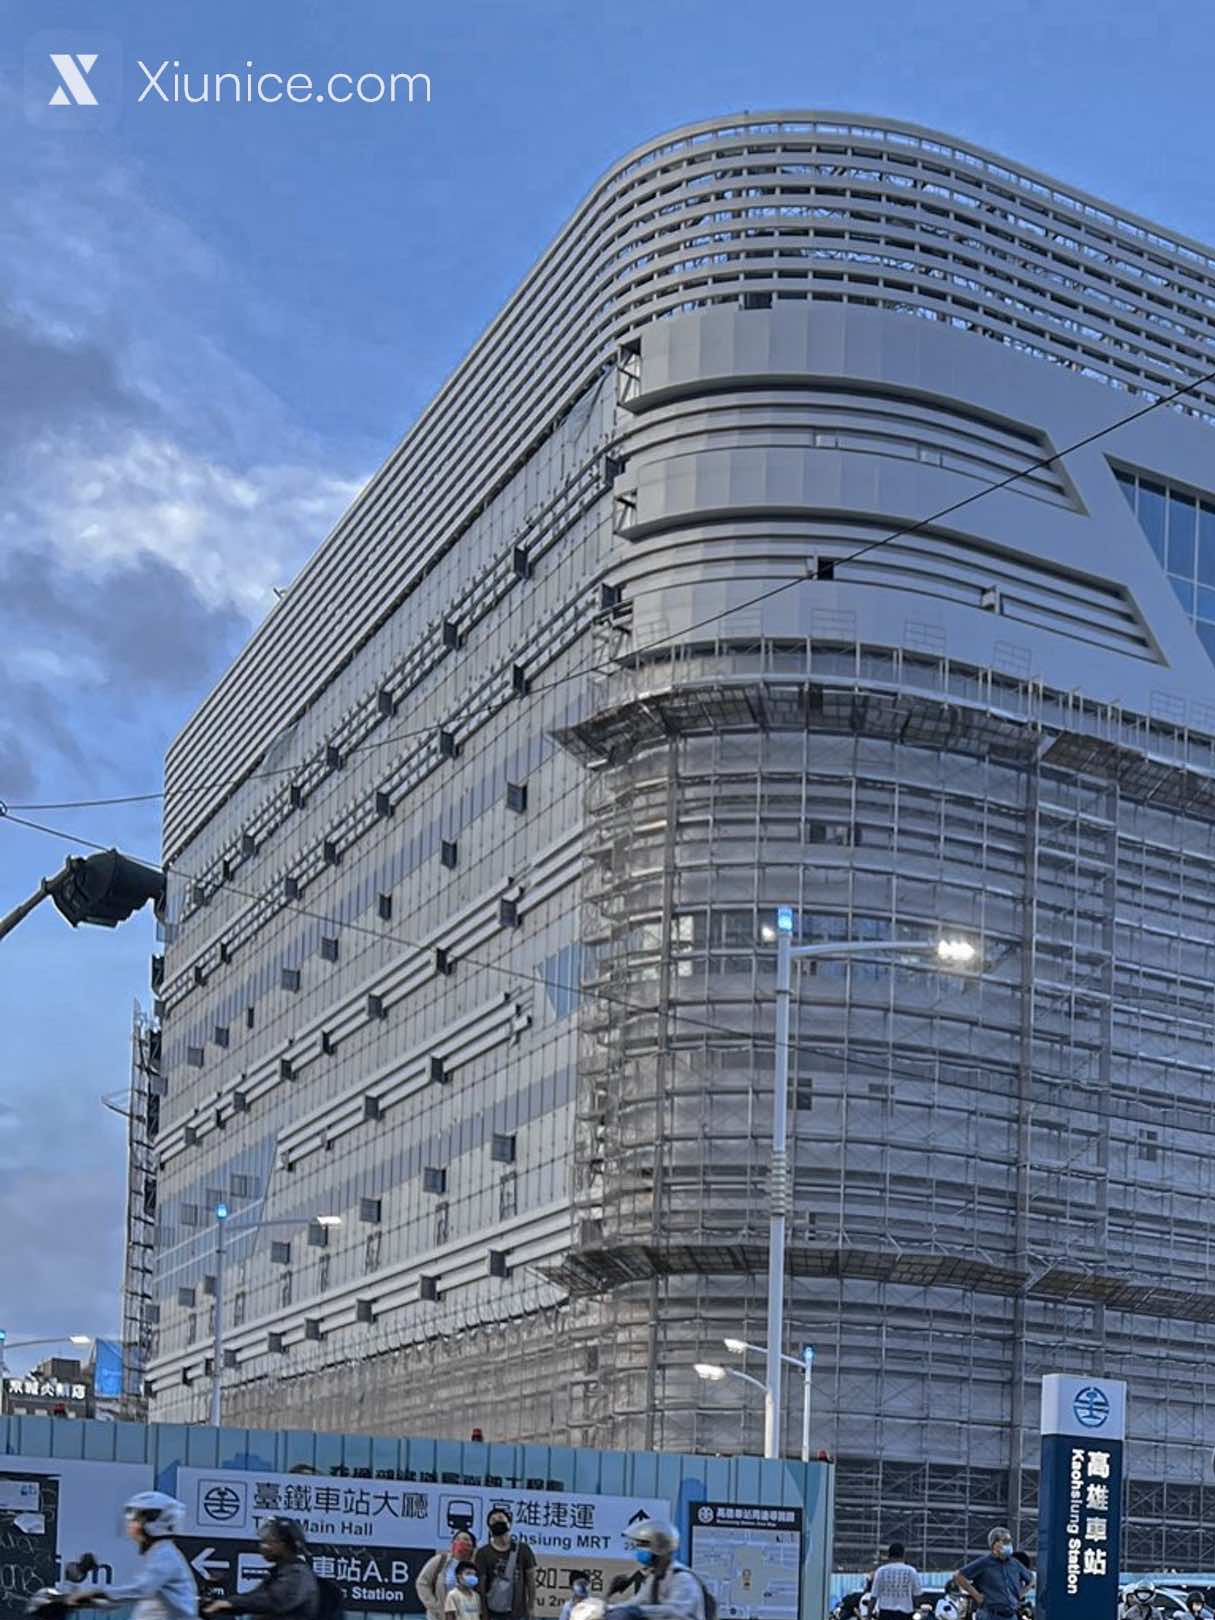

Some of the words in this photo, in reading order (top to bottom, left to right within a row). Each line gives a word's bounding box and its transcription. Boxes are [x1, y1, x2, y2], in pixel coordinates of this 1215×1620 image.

[253, 1482, 428, 1520] 臺鐵車站大廳
[1067, 1449, 1084, 1534] Kaohsiung
[341, 1521, 373, 1536] Hall
[1083, 1451, 1110, 1575] 高雄車站
[577, 1536, 611, 1549] MRT
[298, 1554, 409, 1584] 車站A.B
[1067, 1538, 1082, 1594] Station
[352, 1586, 404, 1602] Station
